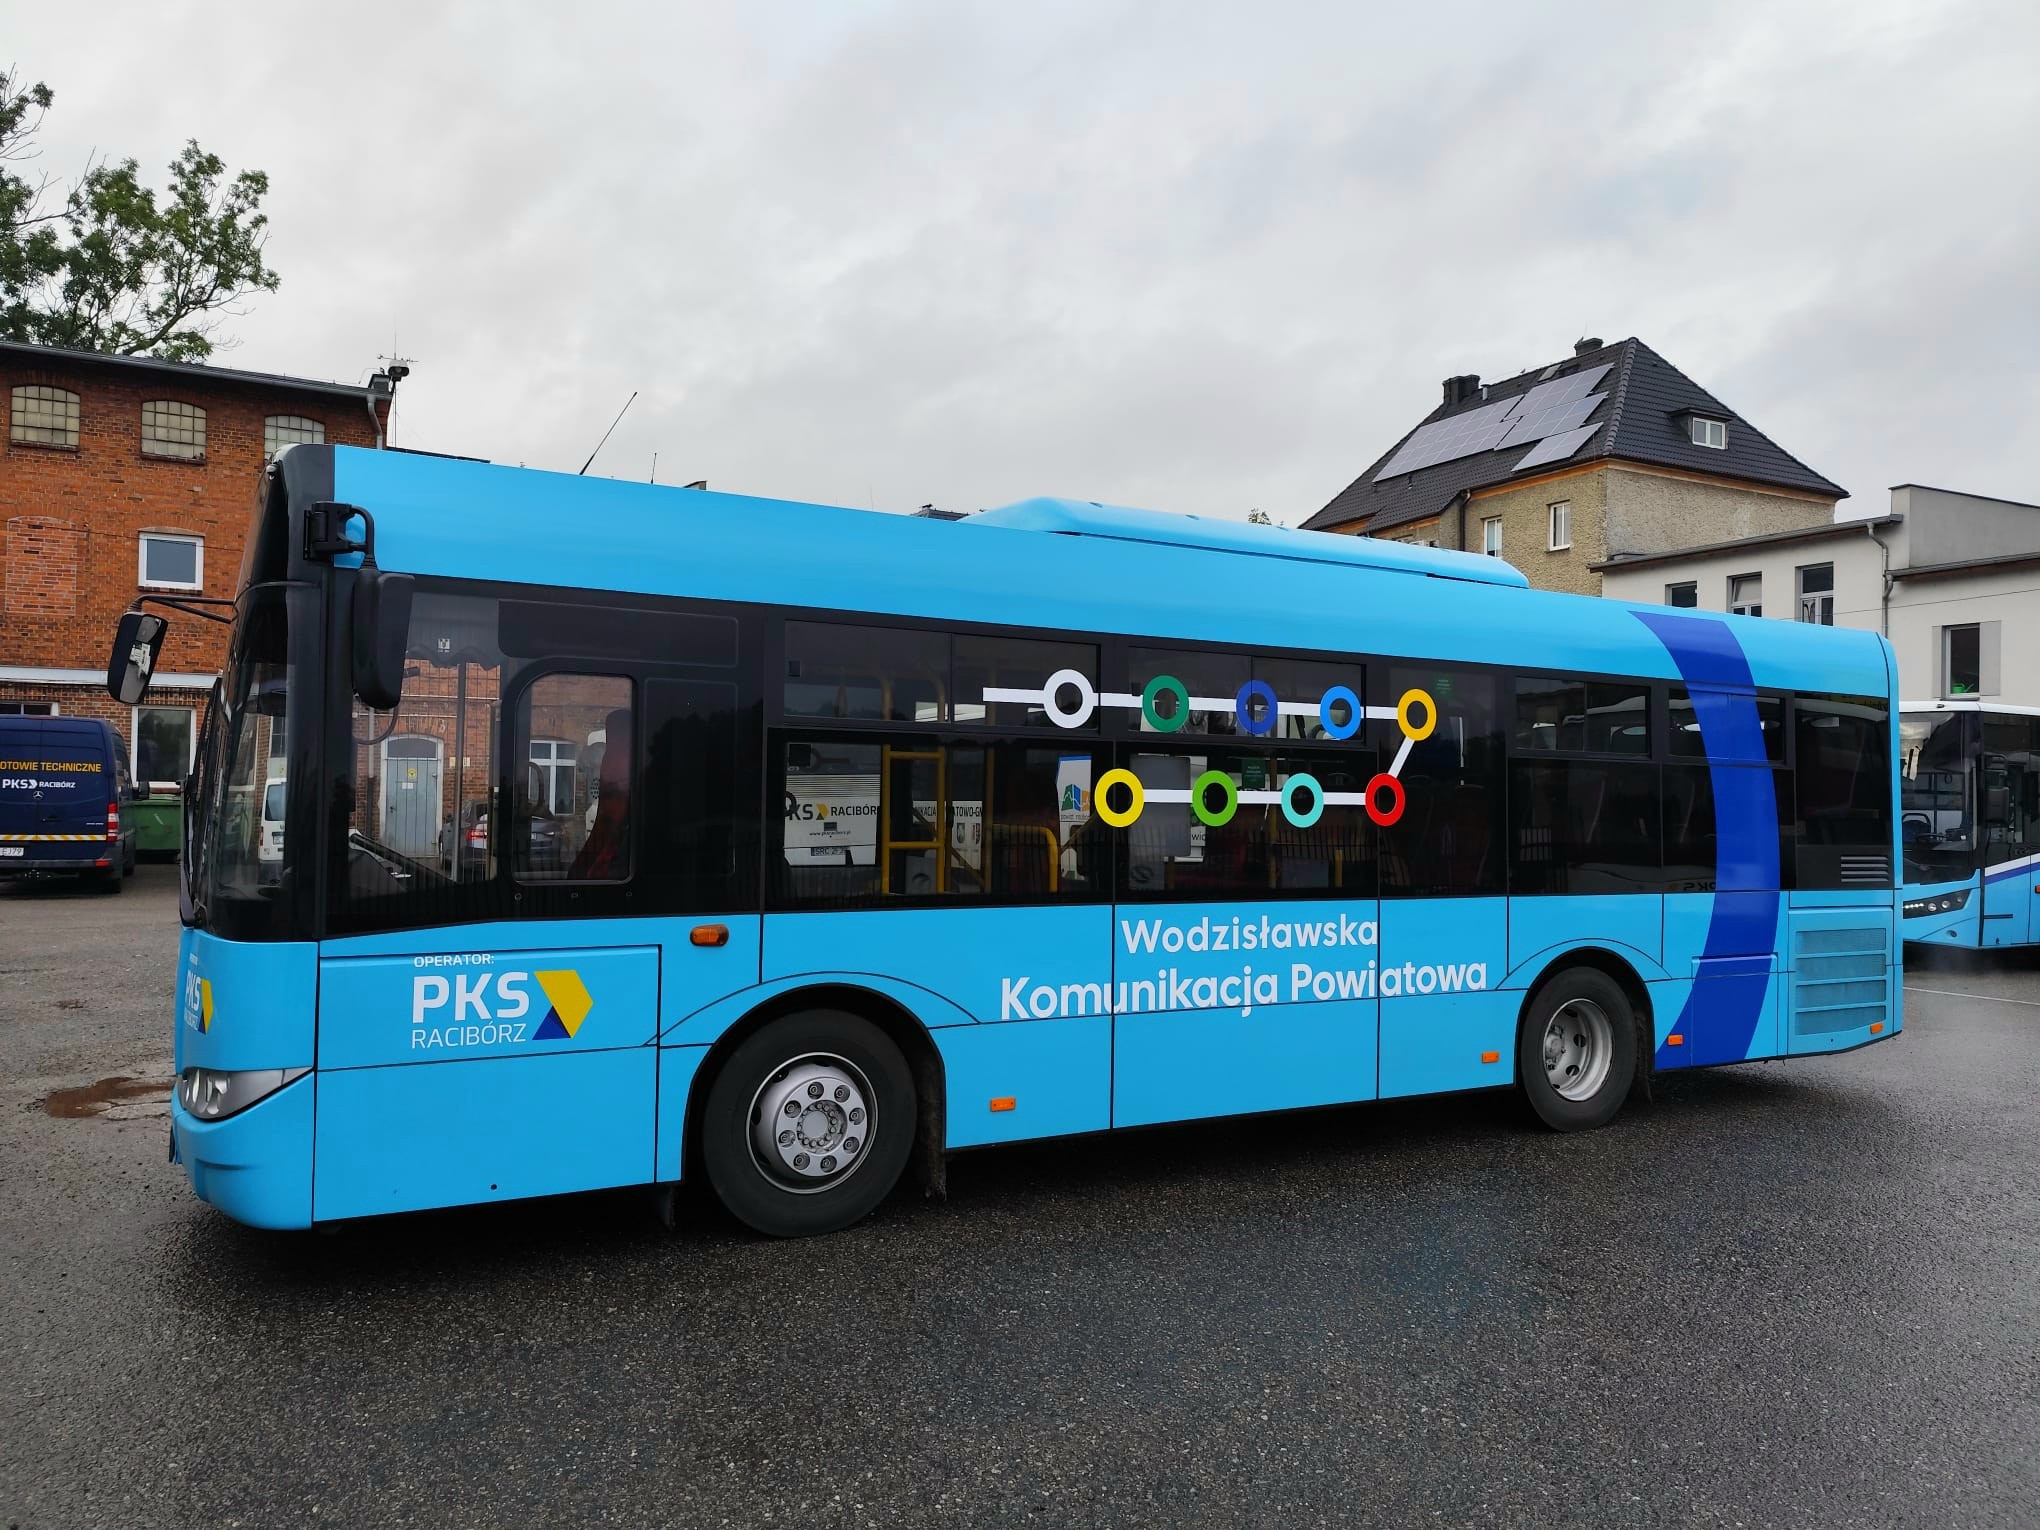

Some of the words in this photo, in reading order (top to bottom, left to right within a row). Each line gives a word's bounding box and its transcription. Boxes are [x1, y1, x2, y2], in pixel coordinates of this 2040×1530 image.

[0, 761, 39, 771] OTOWIE
[41, 762, 102, 772] TECHNICZNE
[2, 779, 28, 789] PKS
[786, 803, 814, 820] KS
[830, 803, 880, 817] RACIBÓR
[1121, 913, 1378, 955] Wodzisławska
[413, 953, 495, 968] OPERATOR:
[184, 968, 202, 1012] PKS
[412, 971, 530, 1024] PKS
[1000, 966, 1279, 1020] Komunikacja
[1290, 959, 1487, 1001] Powiatowa
[411, 1021, 527, 1049] RACIBÓRZ
